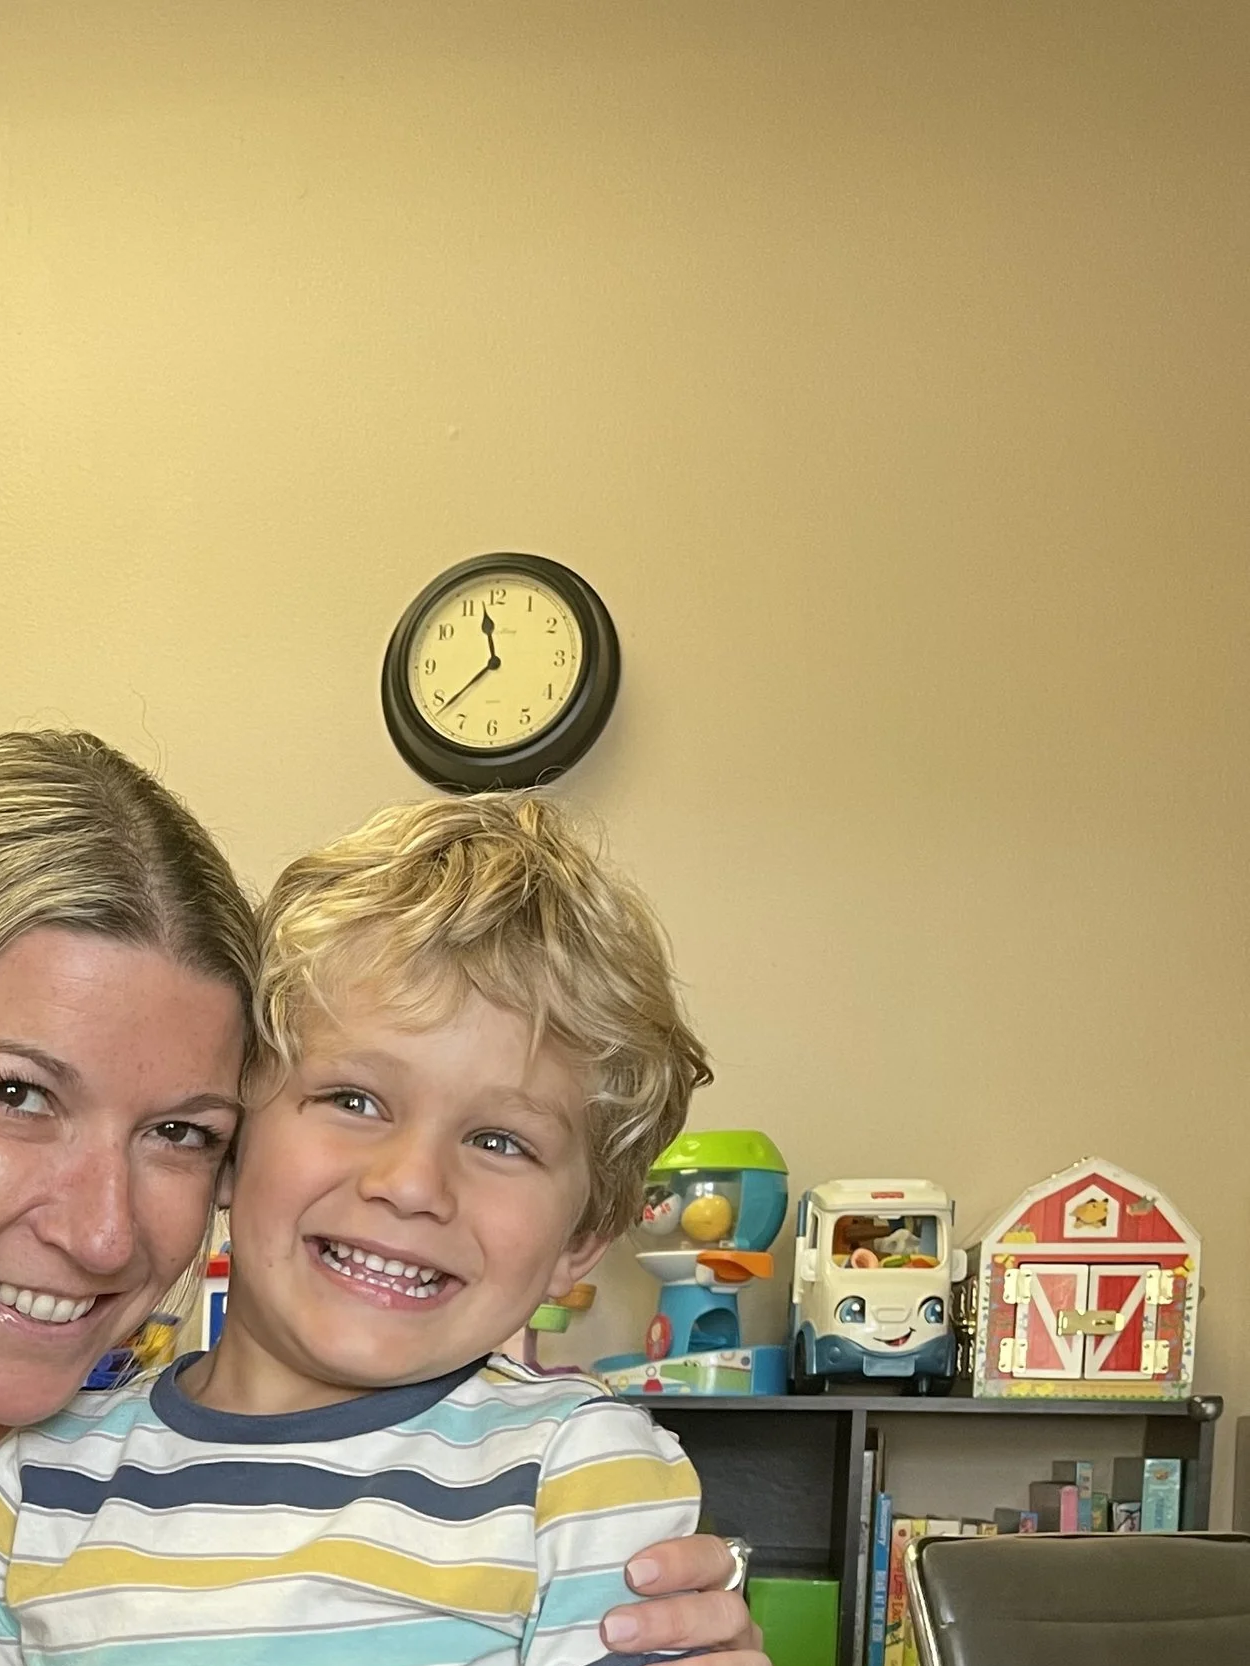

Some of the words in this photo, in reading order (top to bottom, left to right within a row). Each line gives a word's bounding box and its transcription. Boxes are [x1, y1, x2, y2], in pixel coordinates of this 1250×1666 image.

[488, 589, 507, 606] 12
[527, 595, 533, 612] 1
[461, 600, 475, 617] 11
[438, 623, 454, 641] 10
[546, 617, 558, 634] 2
[425, 658, 436, 675] 9
[554, 650, 565, 667] 3
[433, 689, 445, 707] 8
[542, 683, 553, 700] 4
[456, 713, 467, 730] 7
[519, 708, 531, 725] 5
[486, 719, 498, 736] 6
